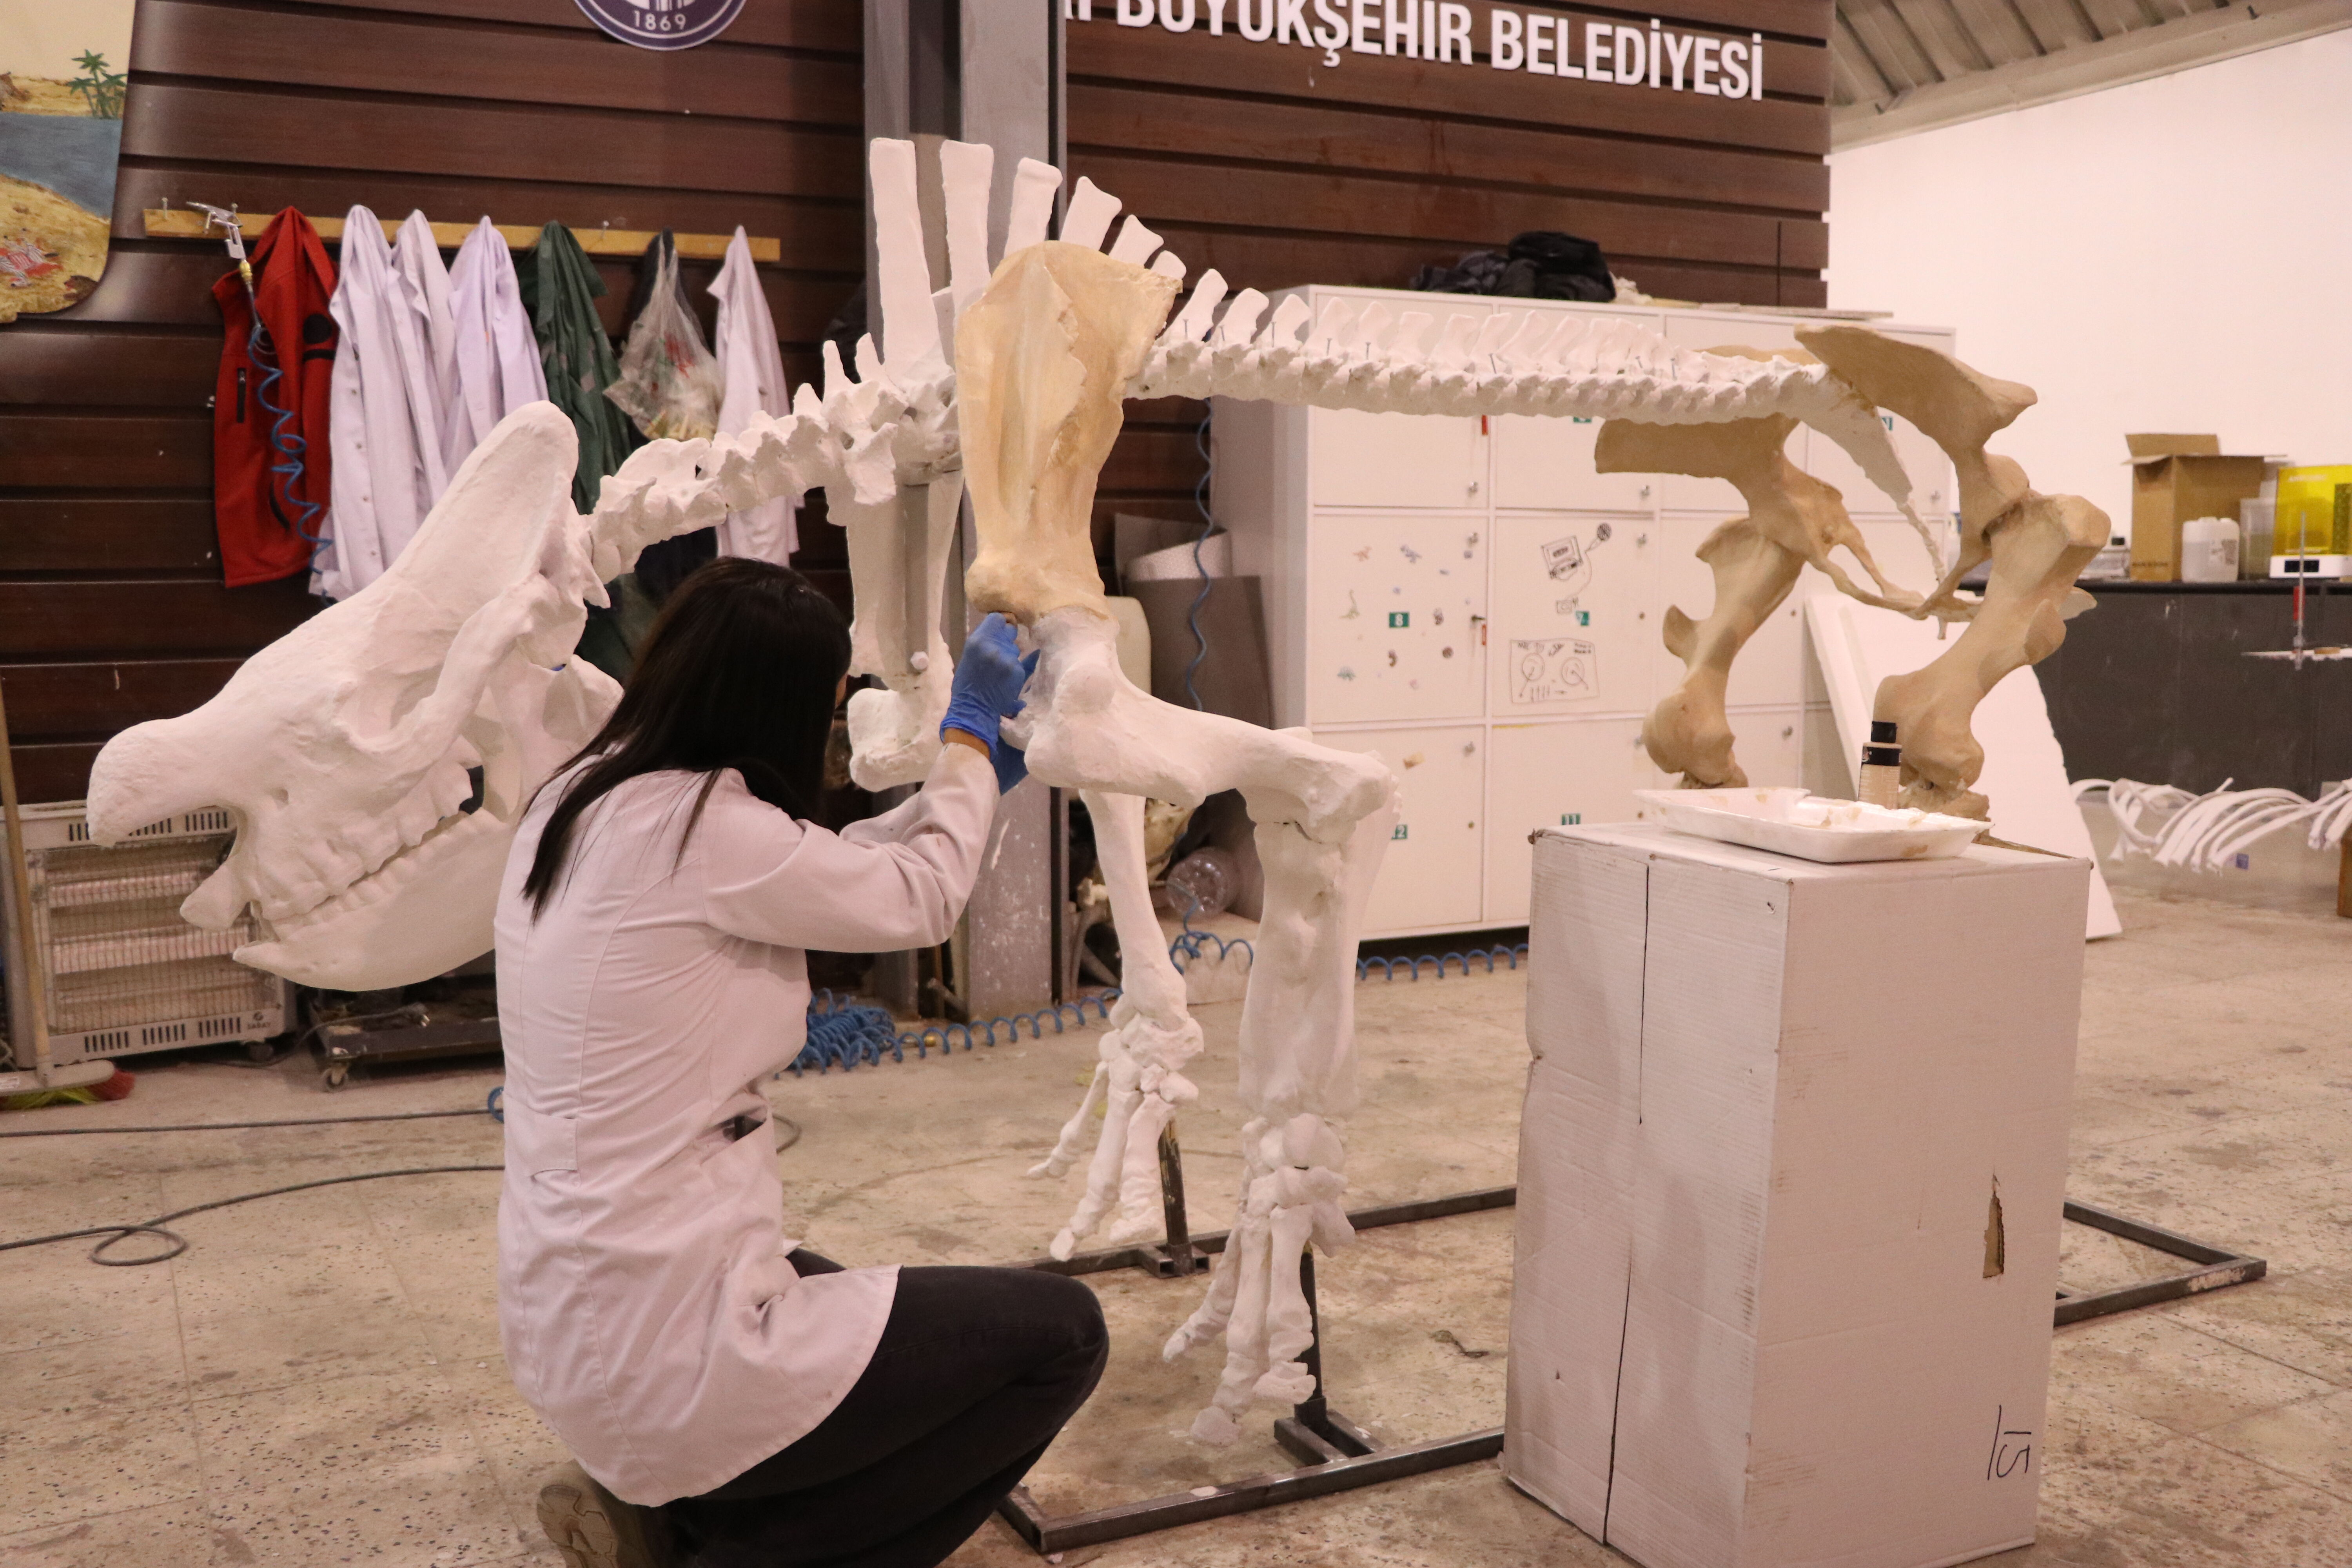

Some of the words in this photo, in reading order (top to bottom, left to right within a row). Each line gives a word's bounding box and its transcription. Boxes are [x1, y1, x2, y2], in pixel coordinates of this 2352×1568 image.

[634, 9, 686, 31] 1869
[1491, 9, 1762, 101] BELEDİYESİ
[1396, 613, 1403, 626] 8
